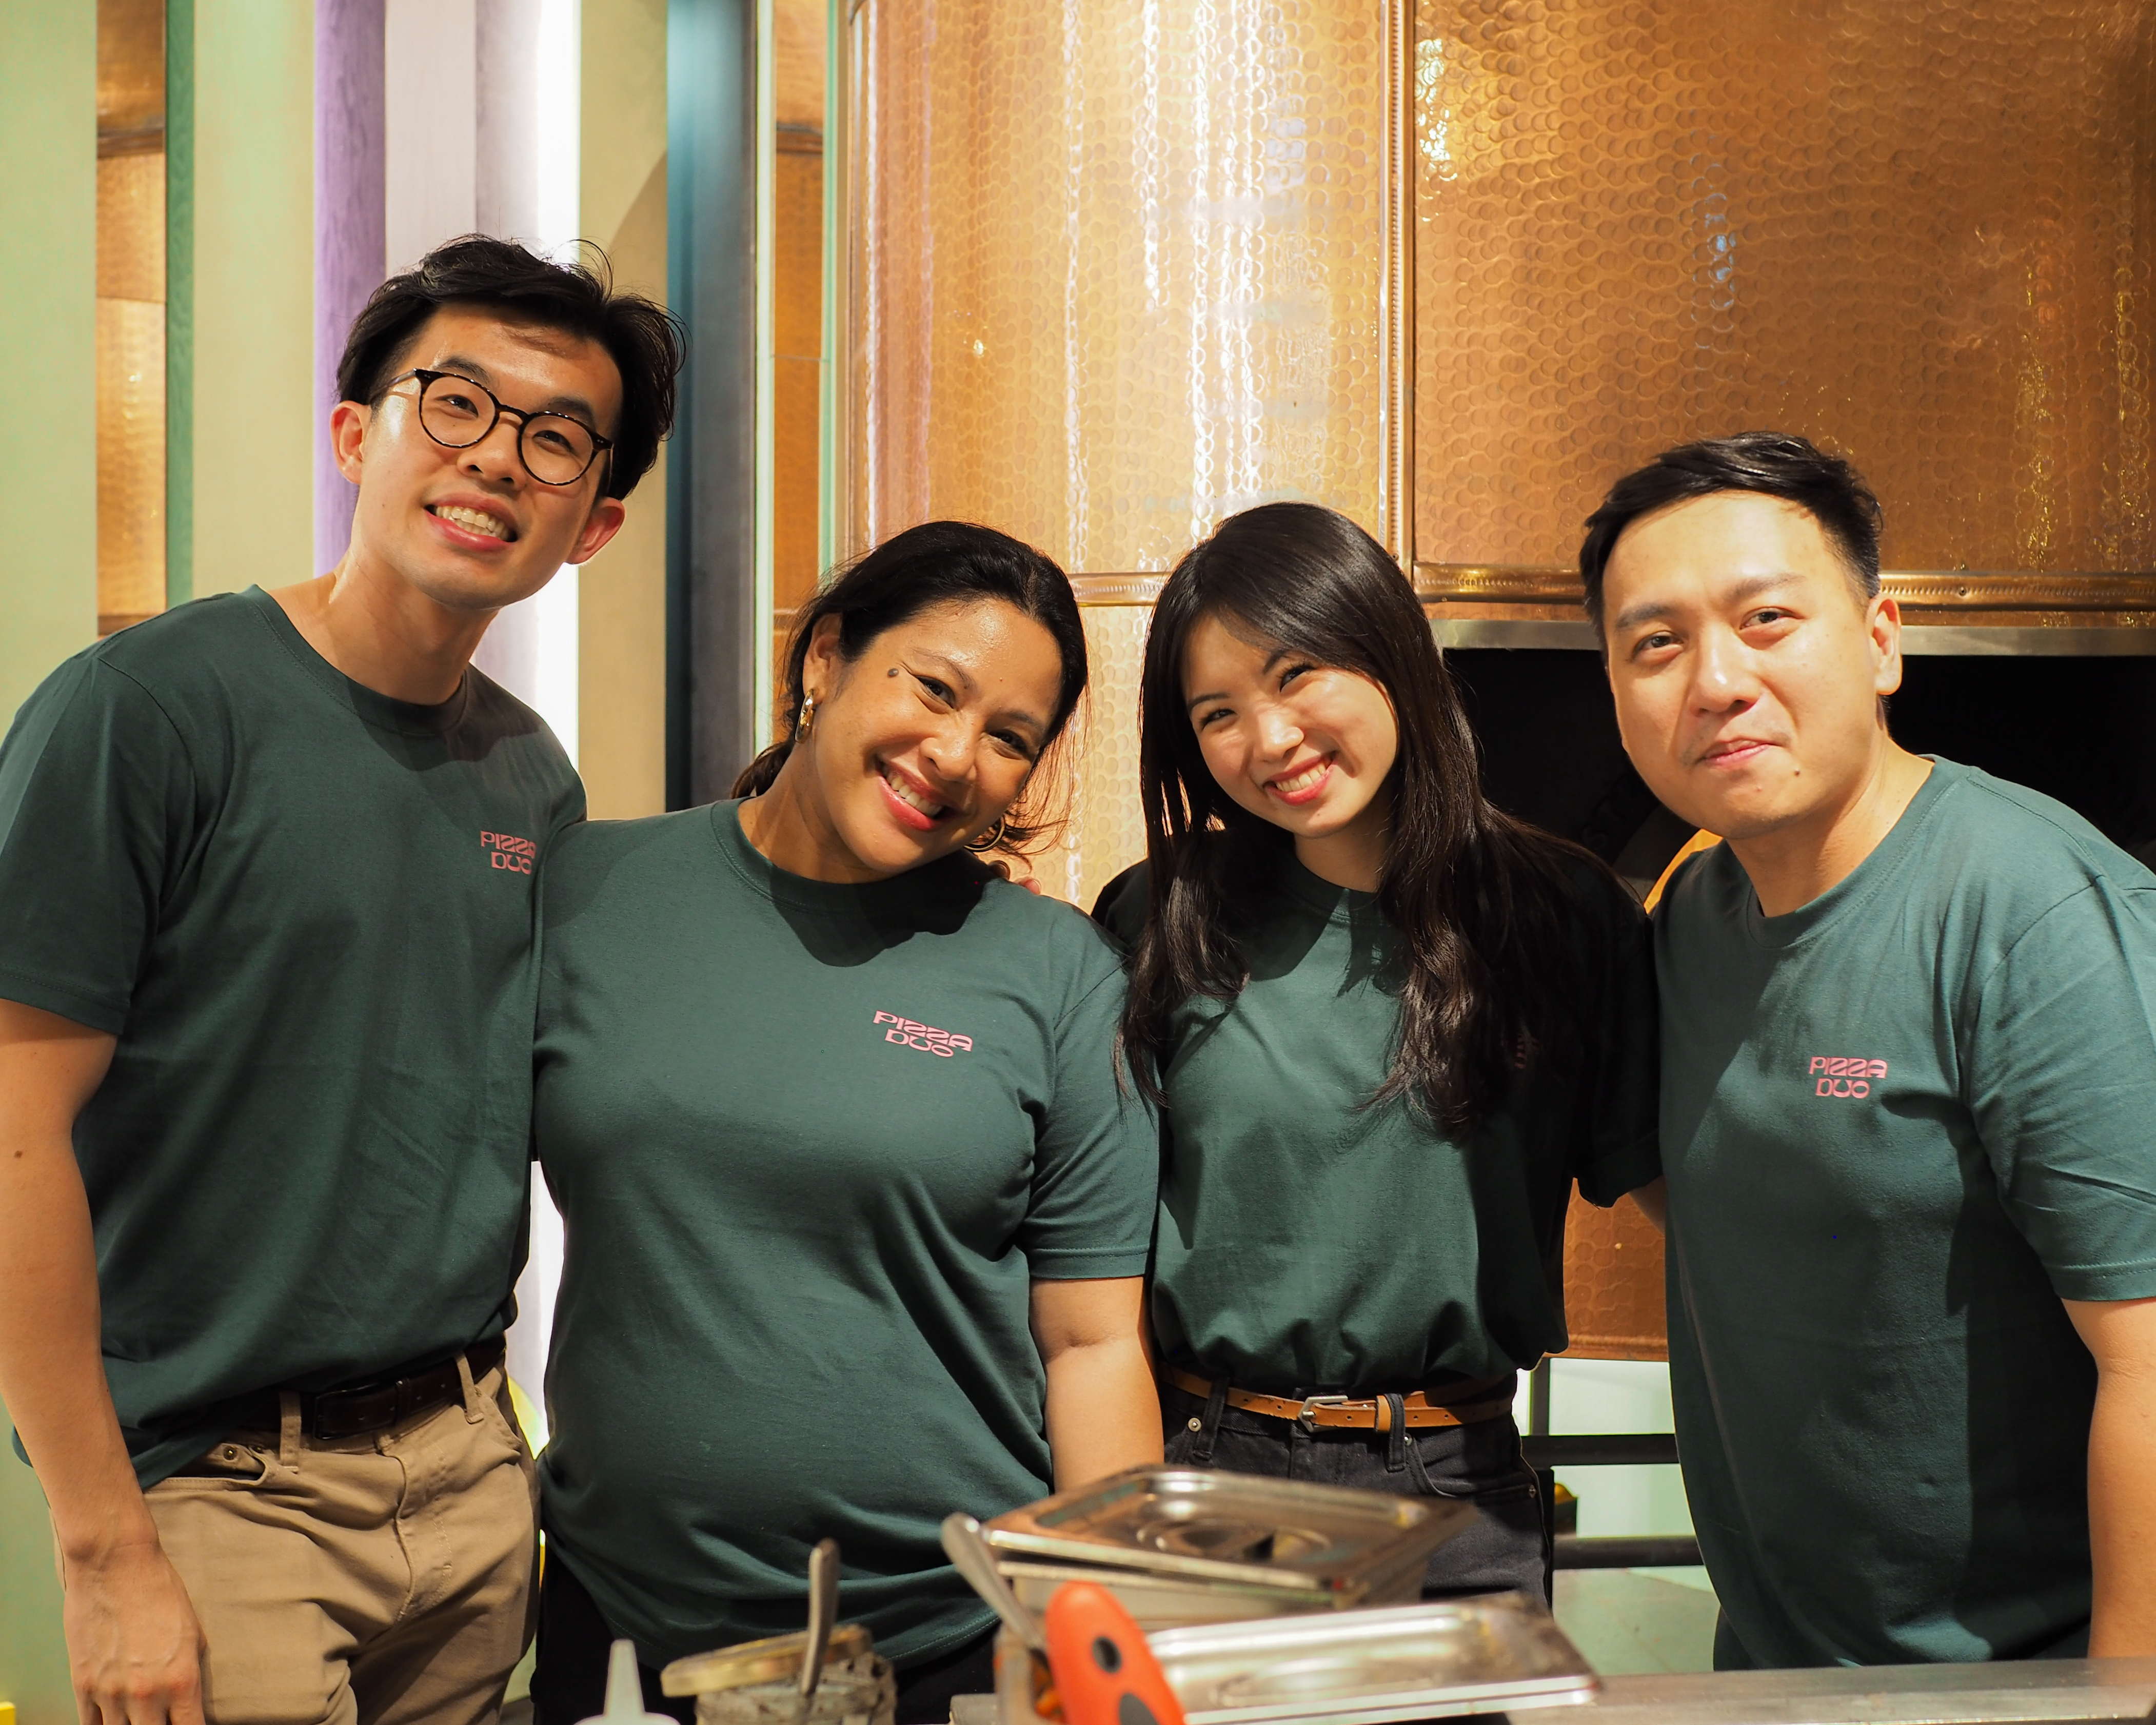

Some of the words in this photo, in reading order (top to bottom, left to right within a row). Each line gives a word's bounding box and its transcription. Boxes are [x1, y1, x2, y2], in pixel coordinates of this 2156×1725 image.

[481, 830, 537, 859] PIZZA
[491, 852, 532, 875] DUO
[873, 1010, 973, 1052] PIZZA
[885, 1028, 954, 1057] DUO
[1809, 1056, 1888, 1079] PIZZA
[1815, 1078, 1870, 1099] DUO
